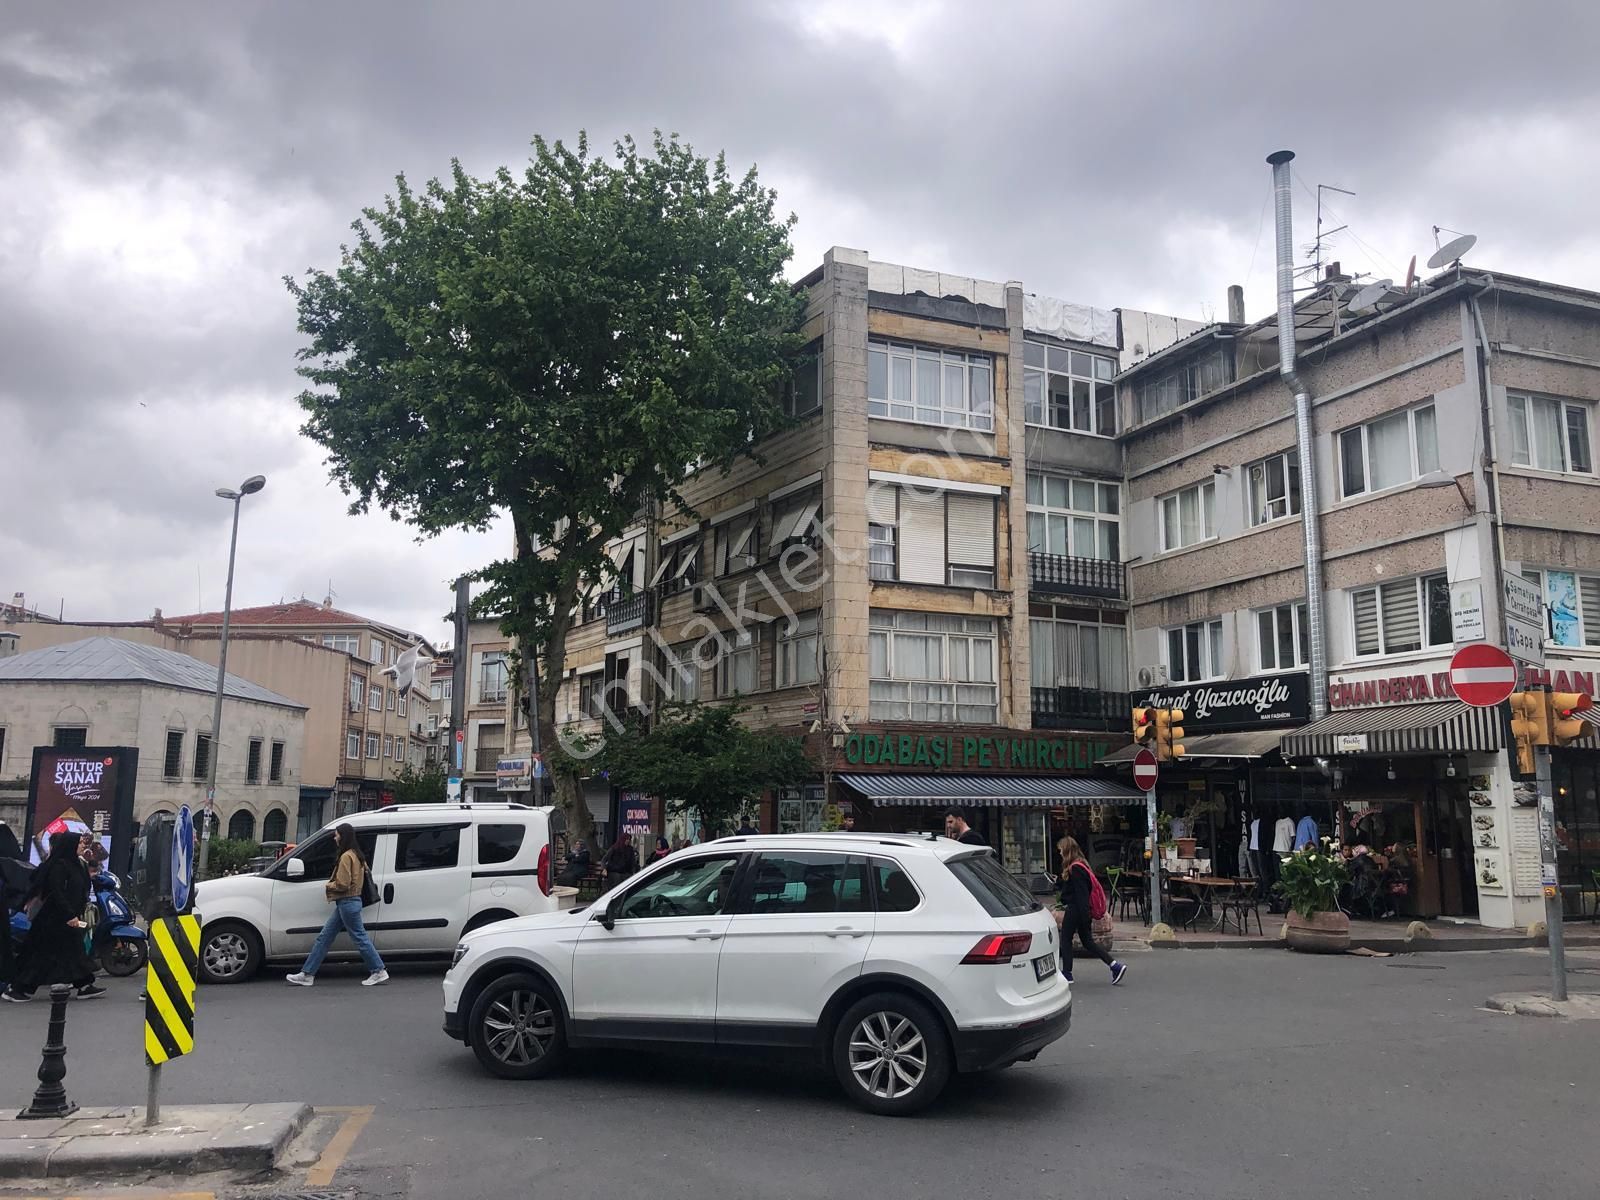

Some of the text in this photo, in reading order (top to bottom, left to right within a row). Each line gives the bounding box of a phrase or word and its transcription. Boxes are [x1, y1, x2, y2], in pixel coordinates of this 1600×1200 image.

[1514, 628, 1533, 652] Çapa
[1194, 679, 1290, 719] Yazıcıoğlu
[1378, 674, 1433, 703] DERYA
[846, 734, 953, 768] ODABAŞI
[54, 771, 103, 784] SANAT
[56, 761, 104, 772] KÜLTÜR
[622, 820, 652, 834] YENİDEN
